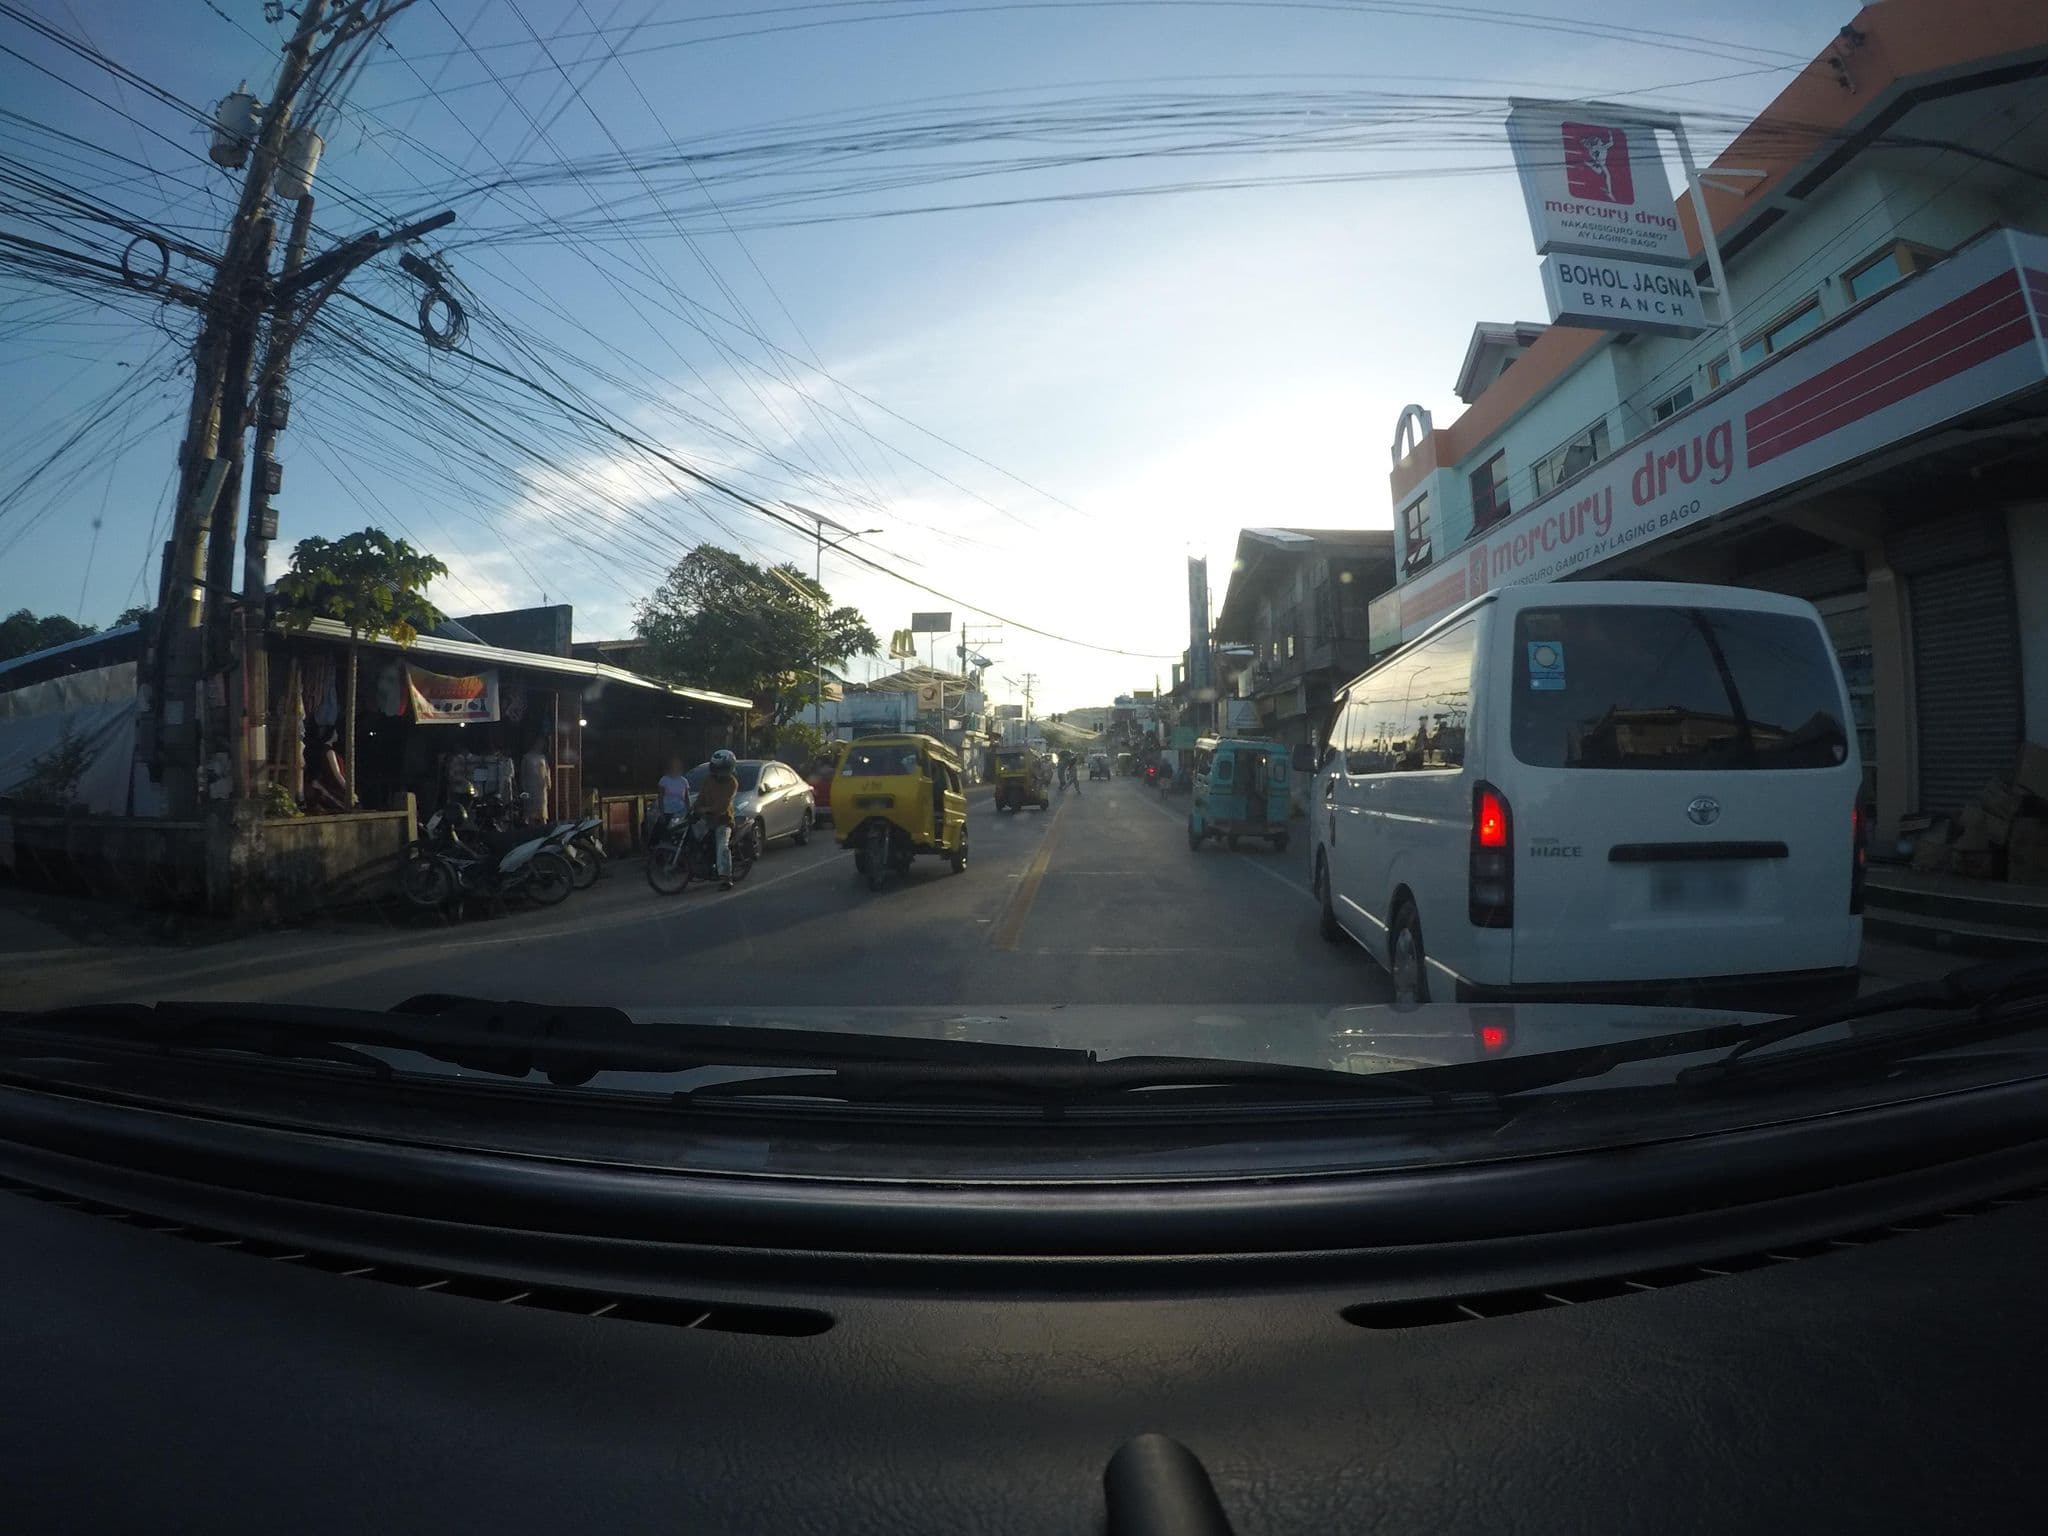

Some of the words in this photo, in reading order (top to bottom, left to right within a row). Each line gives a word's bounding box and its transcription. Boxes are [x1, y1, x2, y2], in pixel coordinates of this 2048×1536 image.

[1544, 200, 1629, 224] mercury
[1635, 210, 1678, 232] drug
[1560, 220, 1634, 236] NAKASISIGURO
[1635, 230, 1668, 241] GAMOT
[1578, 231, 1590, 239] AY
[1592, 232, 1628, 244] LAGING
[1630, 238, 1658, 249] BAGO
[1559, 263, 1628, 290] BOHOL
[1633, 271, 1695, 299] JAGNA
[1583, 292, 1684, 317] BRANCH
[1492, 485, 1612, 578] mercury
[1632, 419, 1733, 507] drug
[1555, 548, 1591, 573] GAMOT
[1592, 541, 1607, 557] AY
[1610, 520, 1656, 549] LAGING
[1660, 499, 1701, 527] BAGO
[1530, 847, 1583, 857] HIACE
